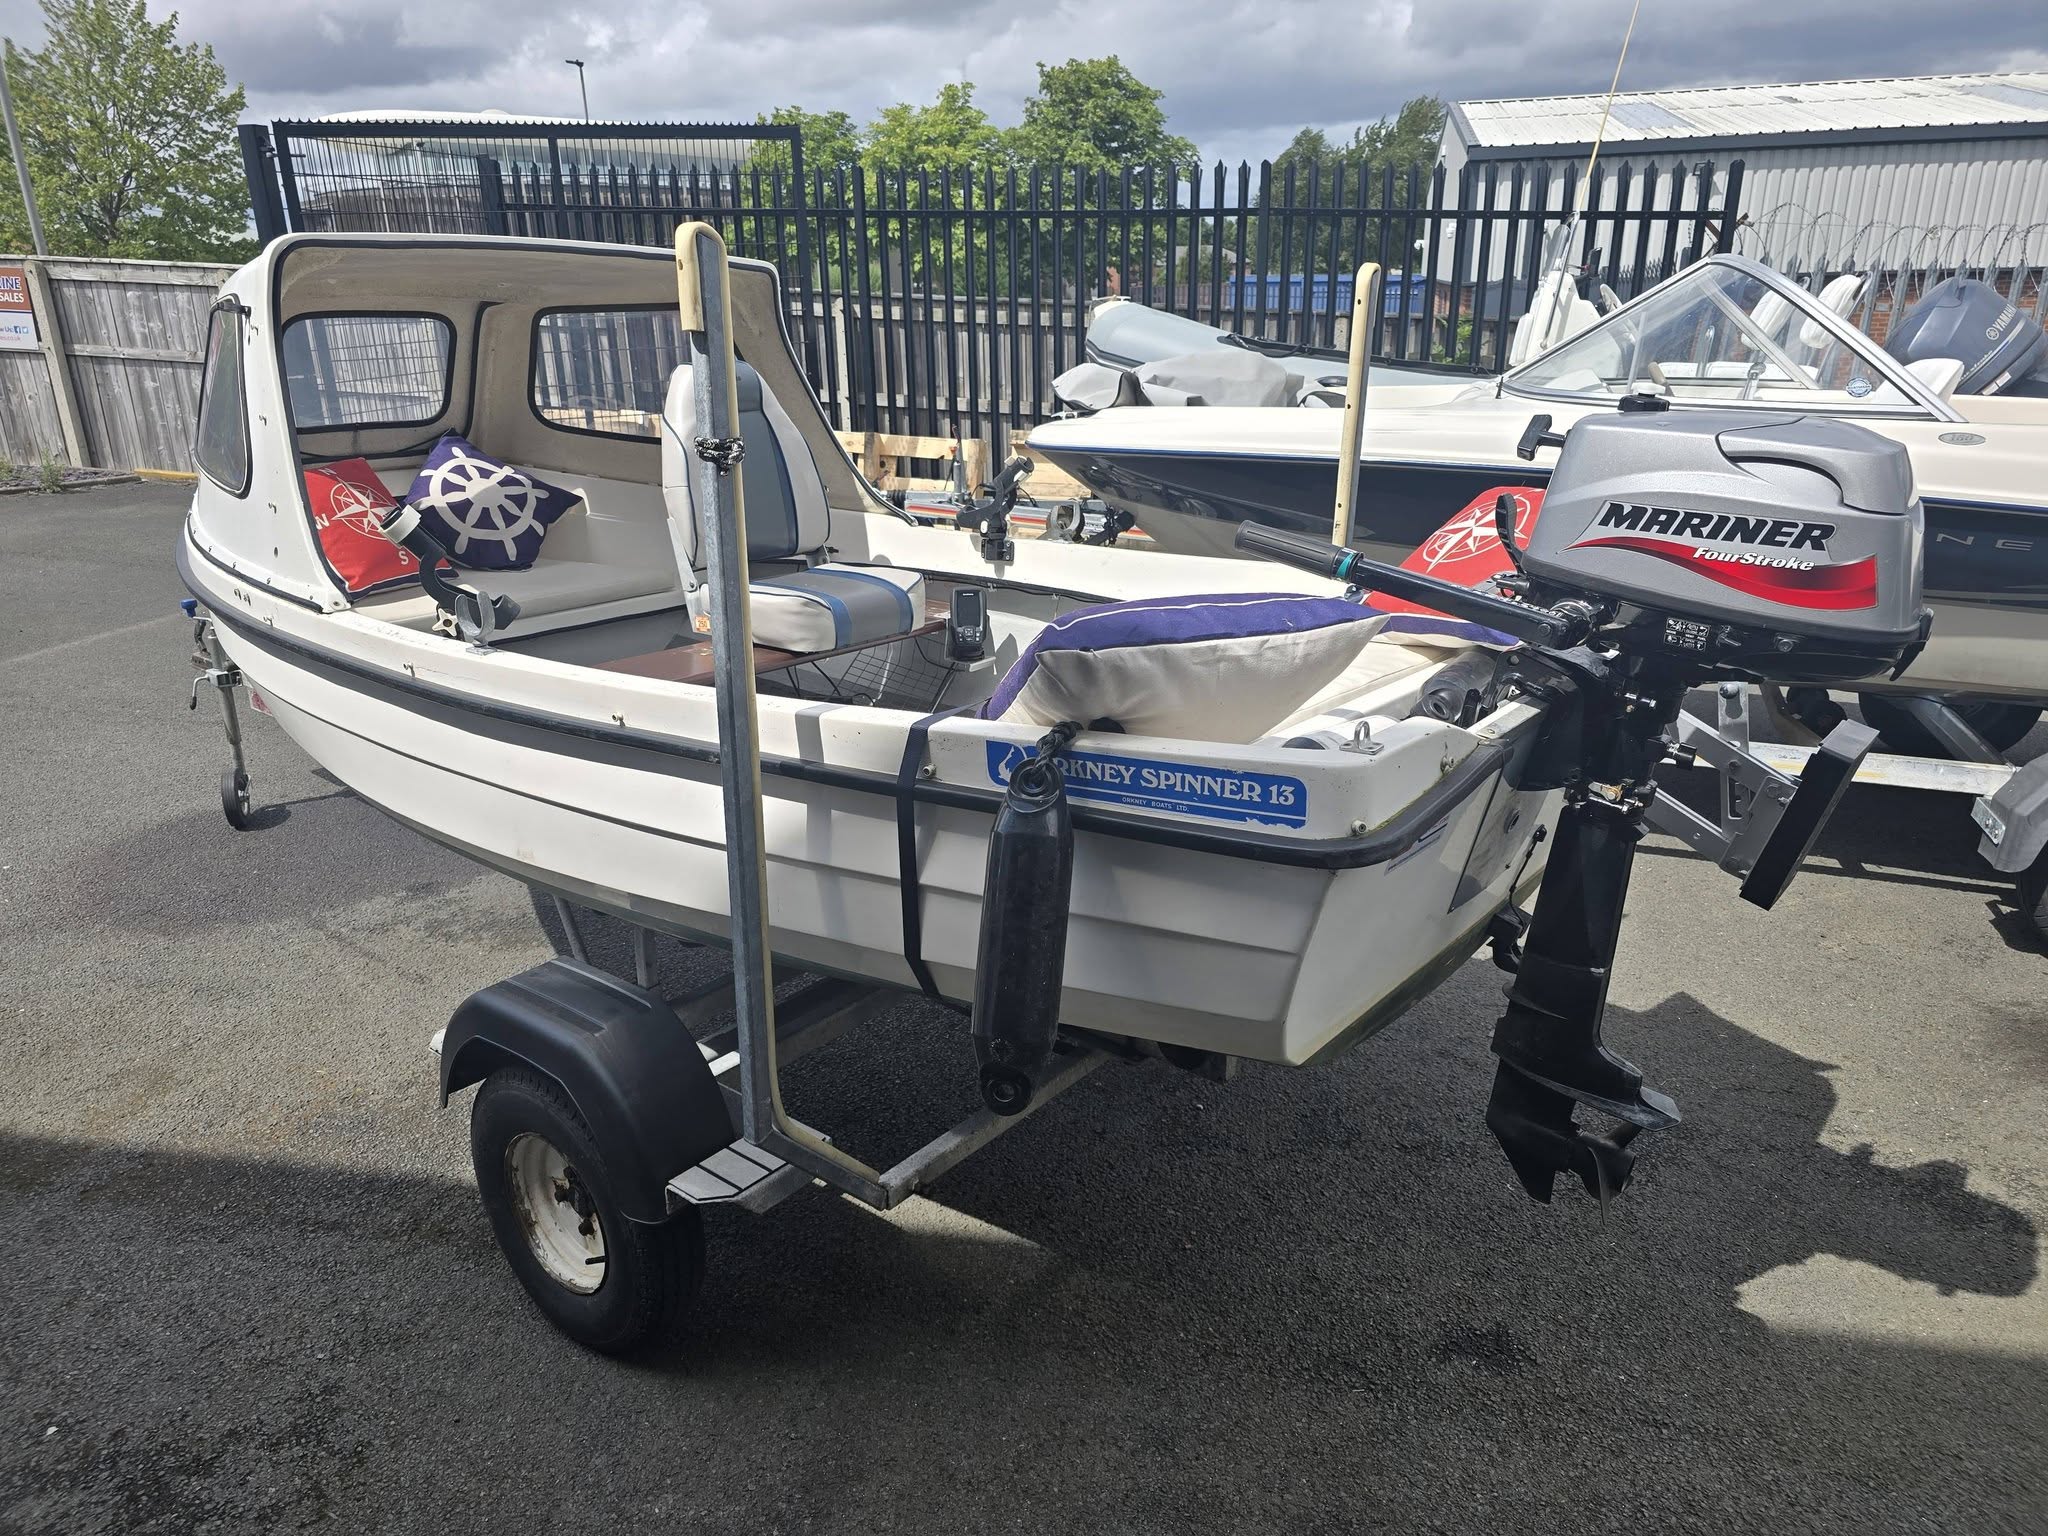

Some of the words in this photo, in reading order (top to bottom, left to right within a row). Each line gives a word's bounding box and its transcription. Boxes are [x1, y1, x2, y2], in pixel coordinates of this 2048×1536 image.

[0, 276, 21, 290] INE
[0, 292, 24, 303] SALES
[1598, 502, 1835, 552] MARINER
[1693, 546, 1816, 572] FourStroke
[1052, 757, 1137, 785] RKNEY
[1139, 767, 1262, 802] SPINNER
[1268, 784, 1296, 806] 13
[1121, 796, 1148, 806] ORKNEY
[1151, 801, 1173, 809] BOATS
